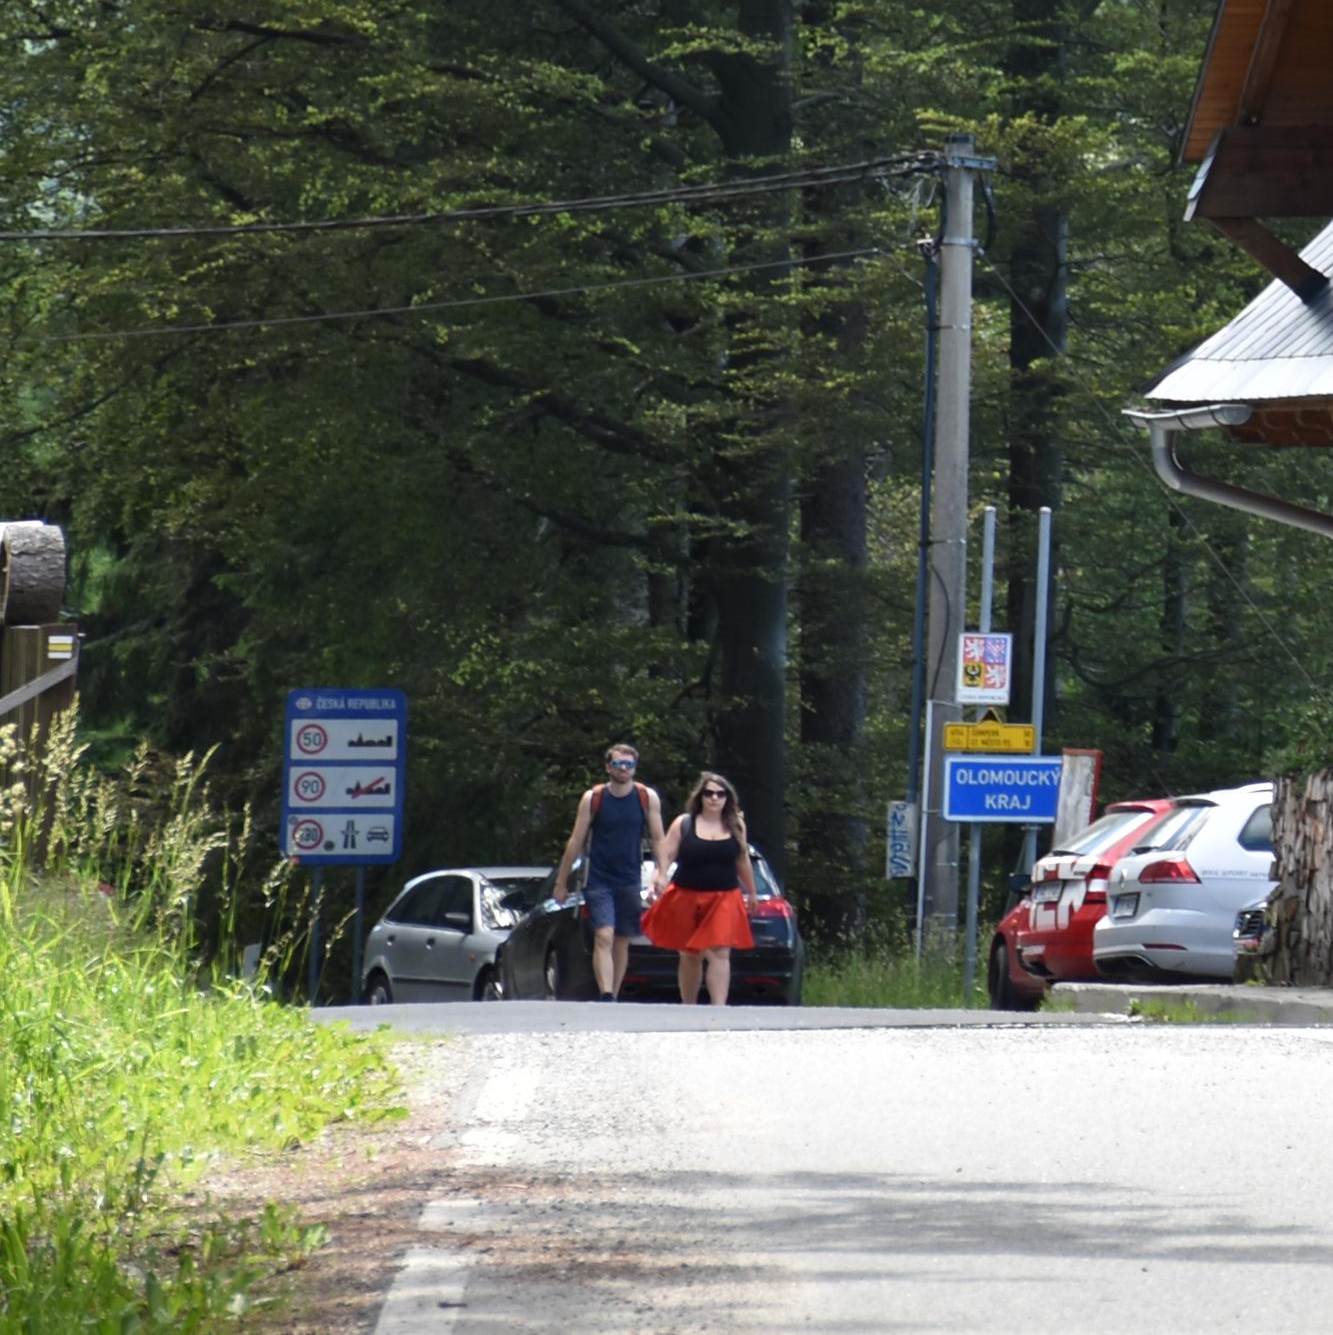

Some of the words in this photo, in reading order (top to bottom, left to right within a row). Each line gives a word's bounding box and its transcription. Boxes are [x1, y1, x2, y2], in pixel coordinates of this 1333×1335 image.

[316, 696, 345, 710] ČESKÁ
[347, 698, 397, 710] REPUBLIKA
[303, 732, 322, 747] 50
[956, 766, 1061, 786] OLOMOUCKÝ
[301, 780, 320, 794] 90
[984, 794, 1031, 810] KRAJ
